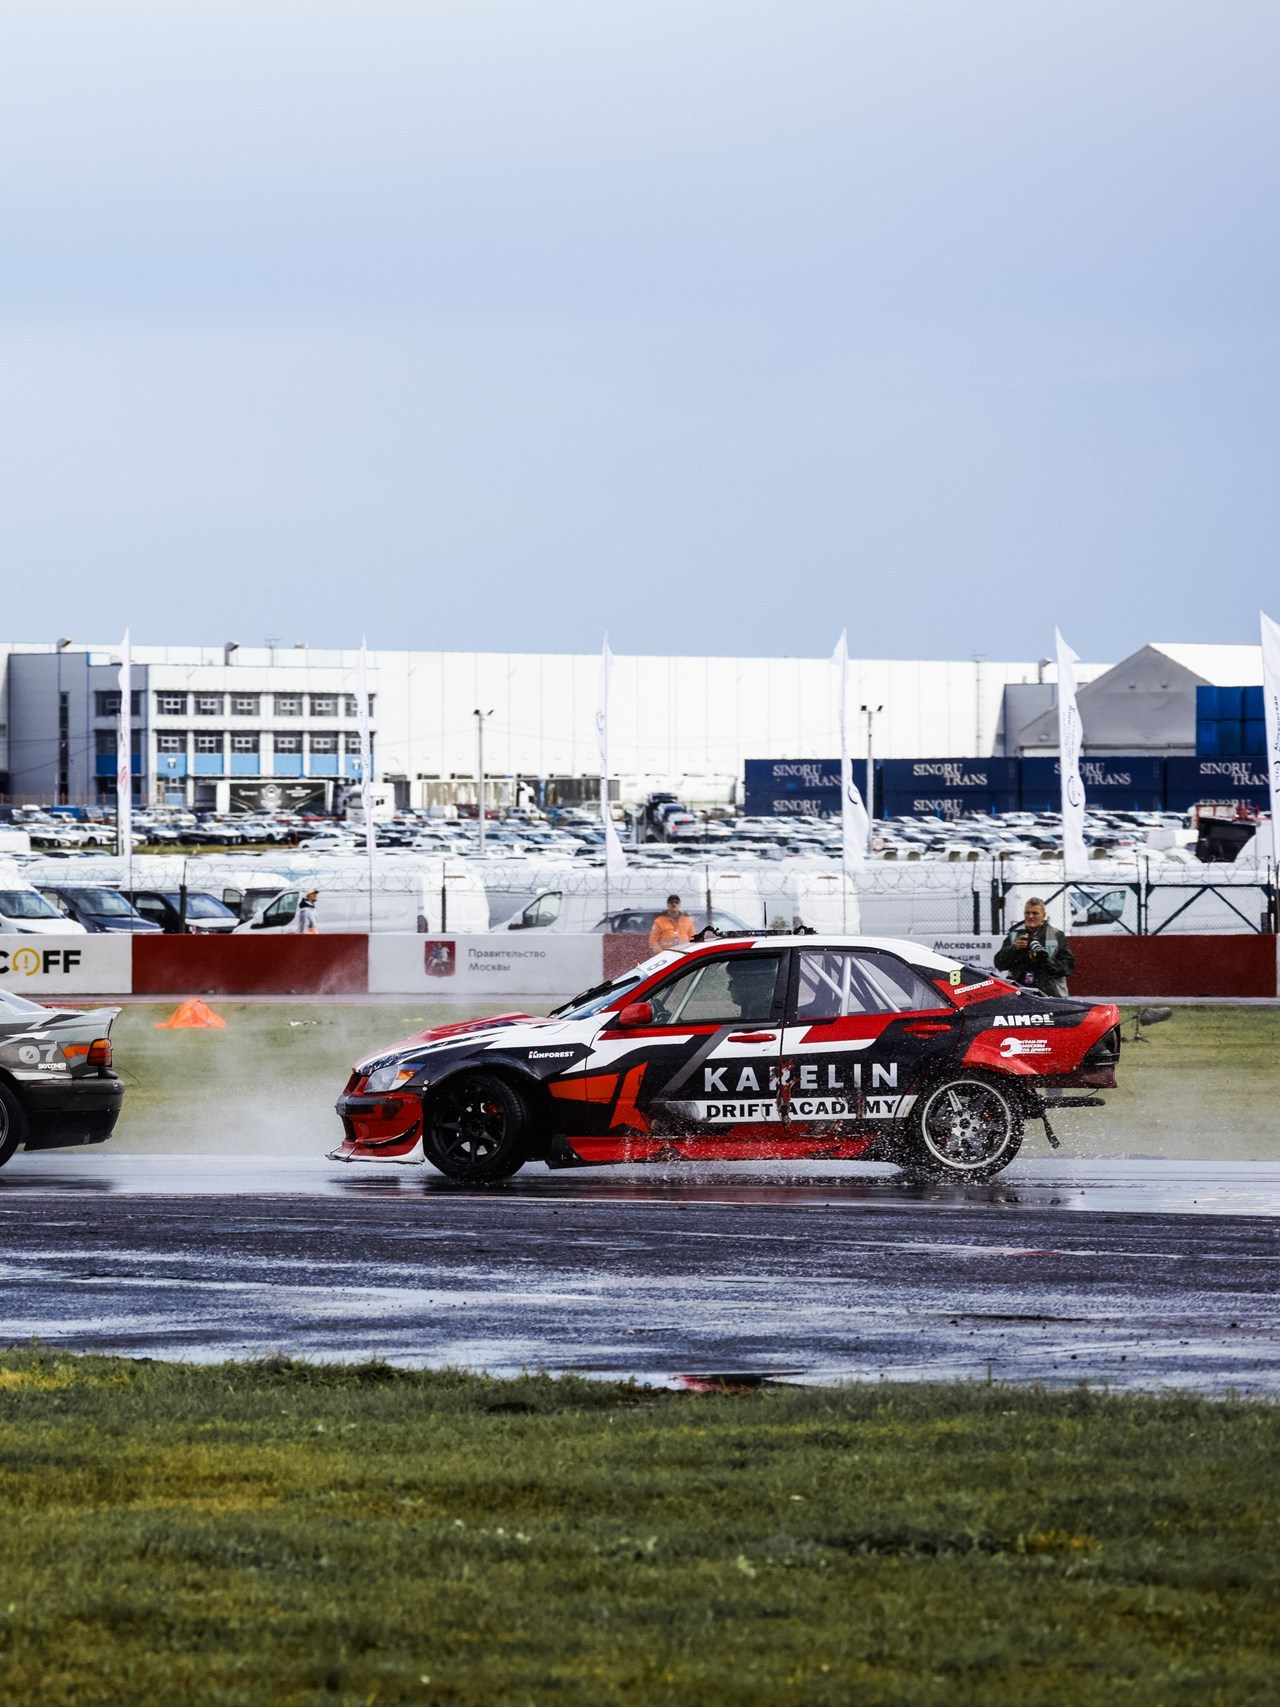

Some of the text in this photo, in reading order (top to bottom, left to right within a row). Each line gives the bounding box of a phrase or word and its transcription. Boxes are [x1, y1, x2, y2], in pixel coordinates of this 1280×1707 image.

[772, 763, 822, 777] SINORU
[913, 763, 963, 777] SINORU
[1053, 762, 1105, 775] SORU
[1199, 762, 1252, 775] SINORU
[803, 774, 842, 787] TRAN
[943, 773, 987, 786] TRANS
[1086, 773, 1132, 785] TRANS
[1232, 773, 1270, 785] TRAN
[772, 799, 821, 812] SINORU
[913, 798, 963, 812] SINORU
[933, 940, 993, 950] Московская
[468, 948, 547, 960] Правительство
[468, 962, 511, 972] Москвы
[949, 969, 961, 986] 8
[18, 1043, 58, 1065] 07
[706, 1102, 774, 1118] DRIFT
